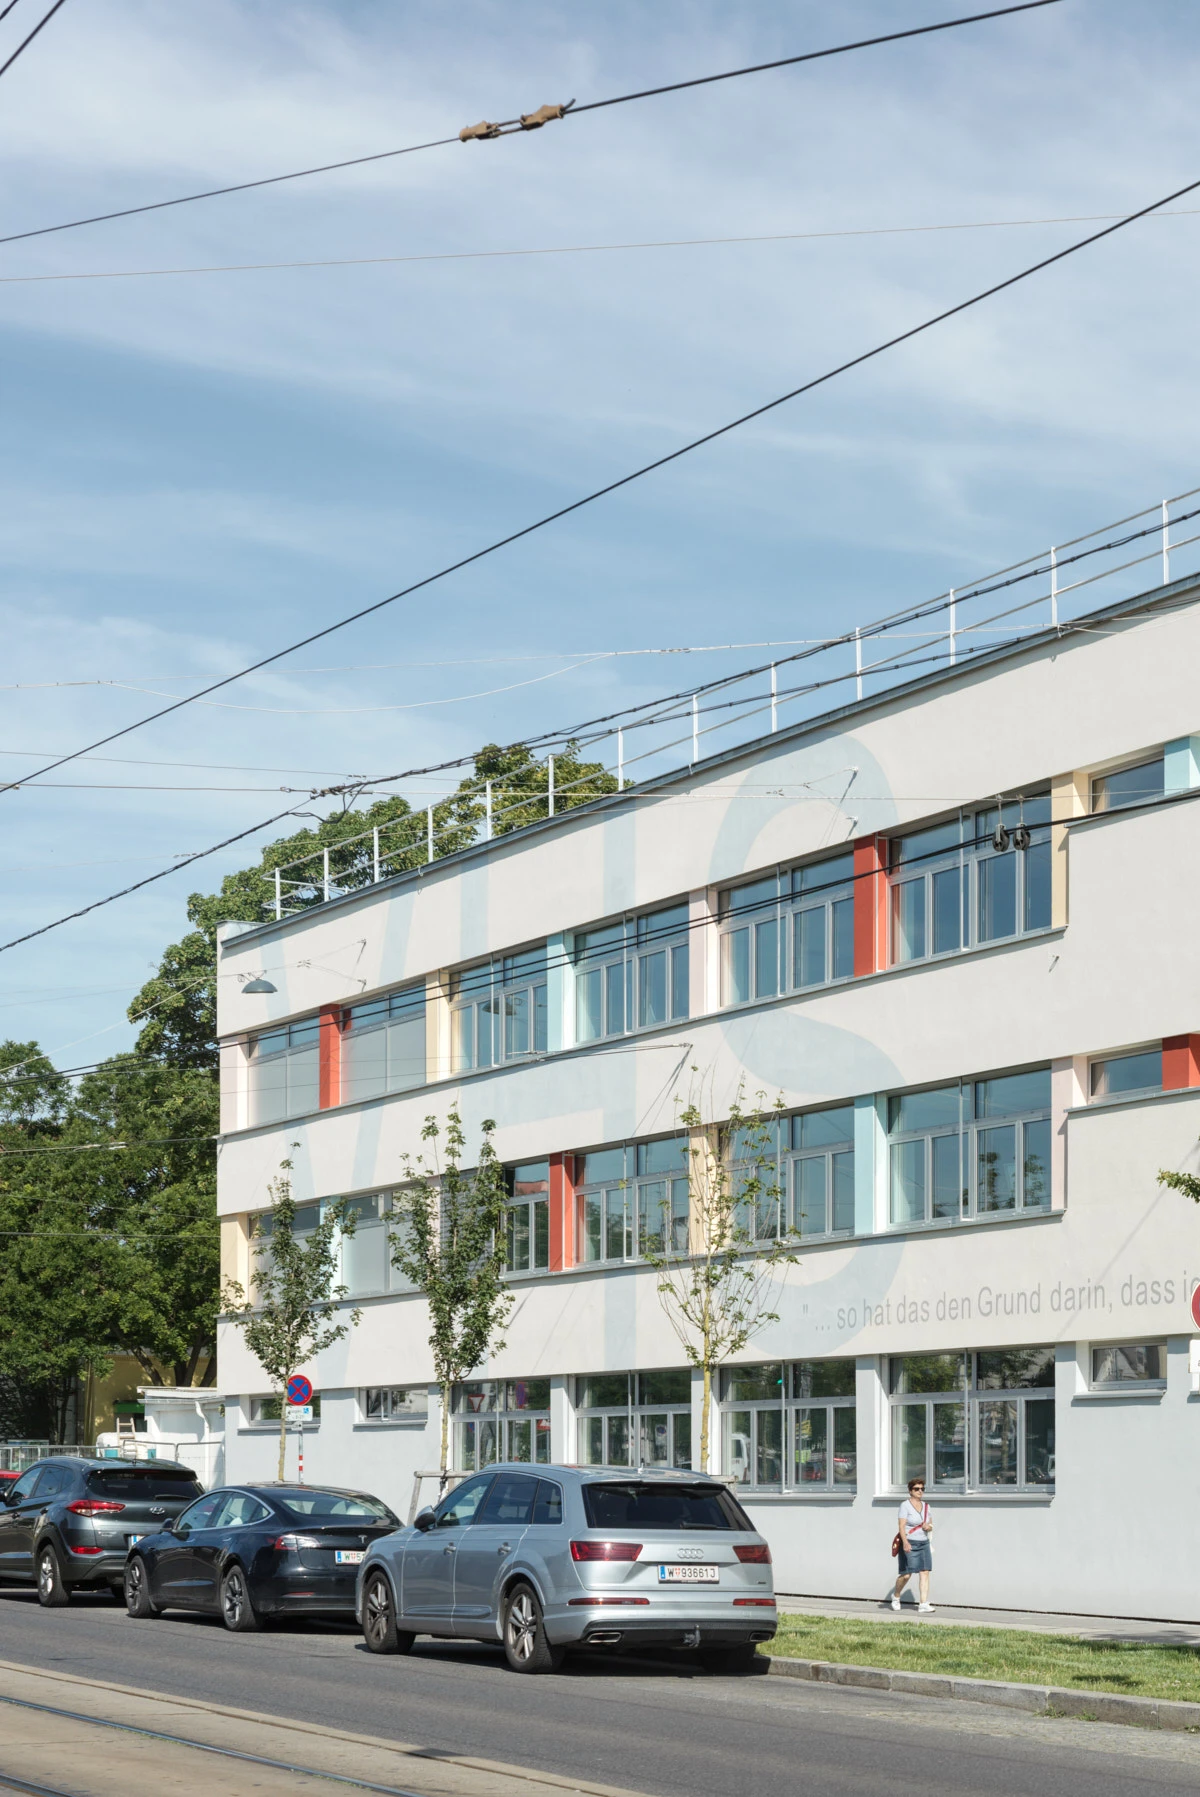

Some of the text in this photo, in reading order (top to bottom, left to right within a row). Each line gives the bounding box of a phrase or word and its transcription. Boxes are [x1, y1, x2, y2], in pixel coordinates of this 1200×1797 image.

[836, 1306, 858, 1330] so
[862, 1298, 892, 1327] hat
[896, 1294, 930, 1324] das
[935, 1291, 972, 1321] den
[977, 1282, 1042, 1317] Grund
[1050, 1277, 1113, 1313] darin,
[1120, 1274, 1176, 1307] dass
